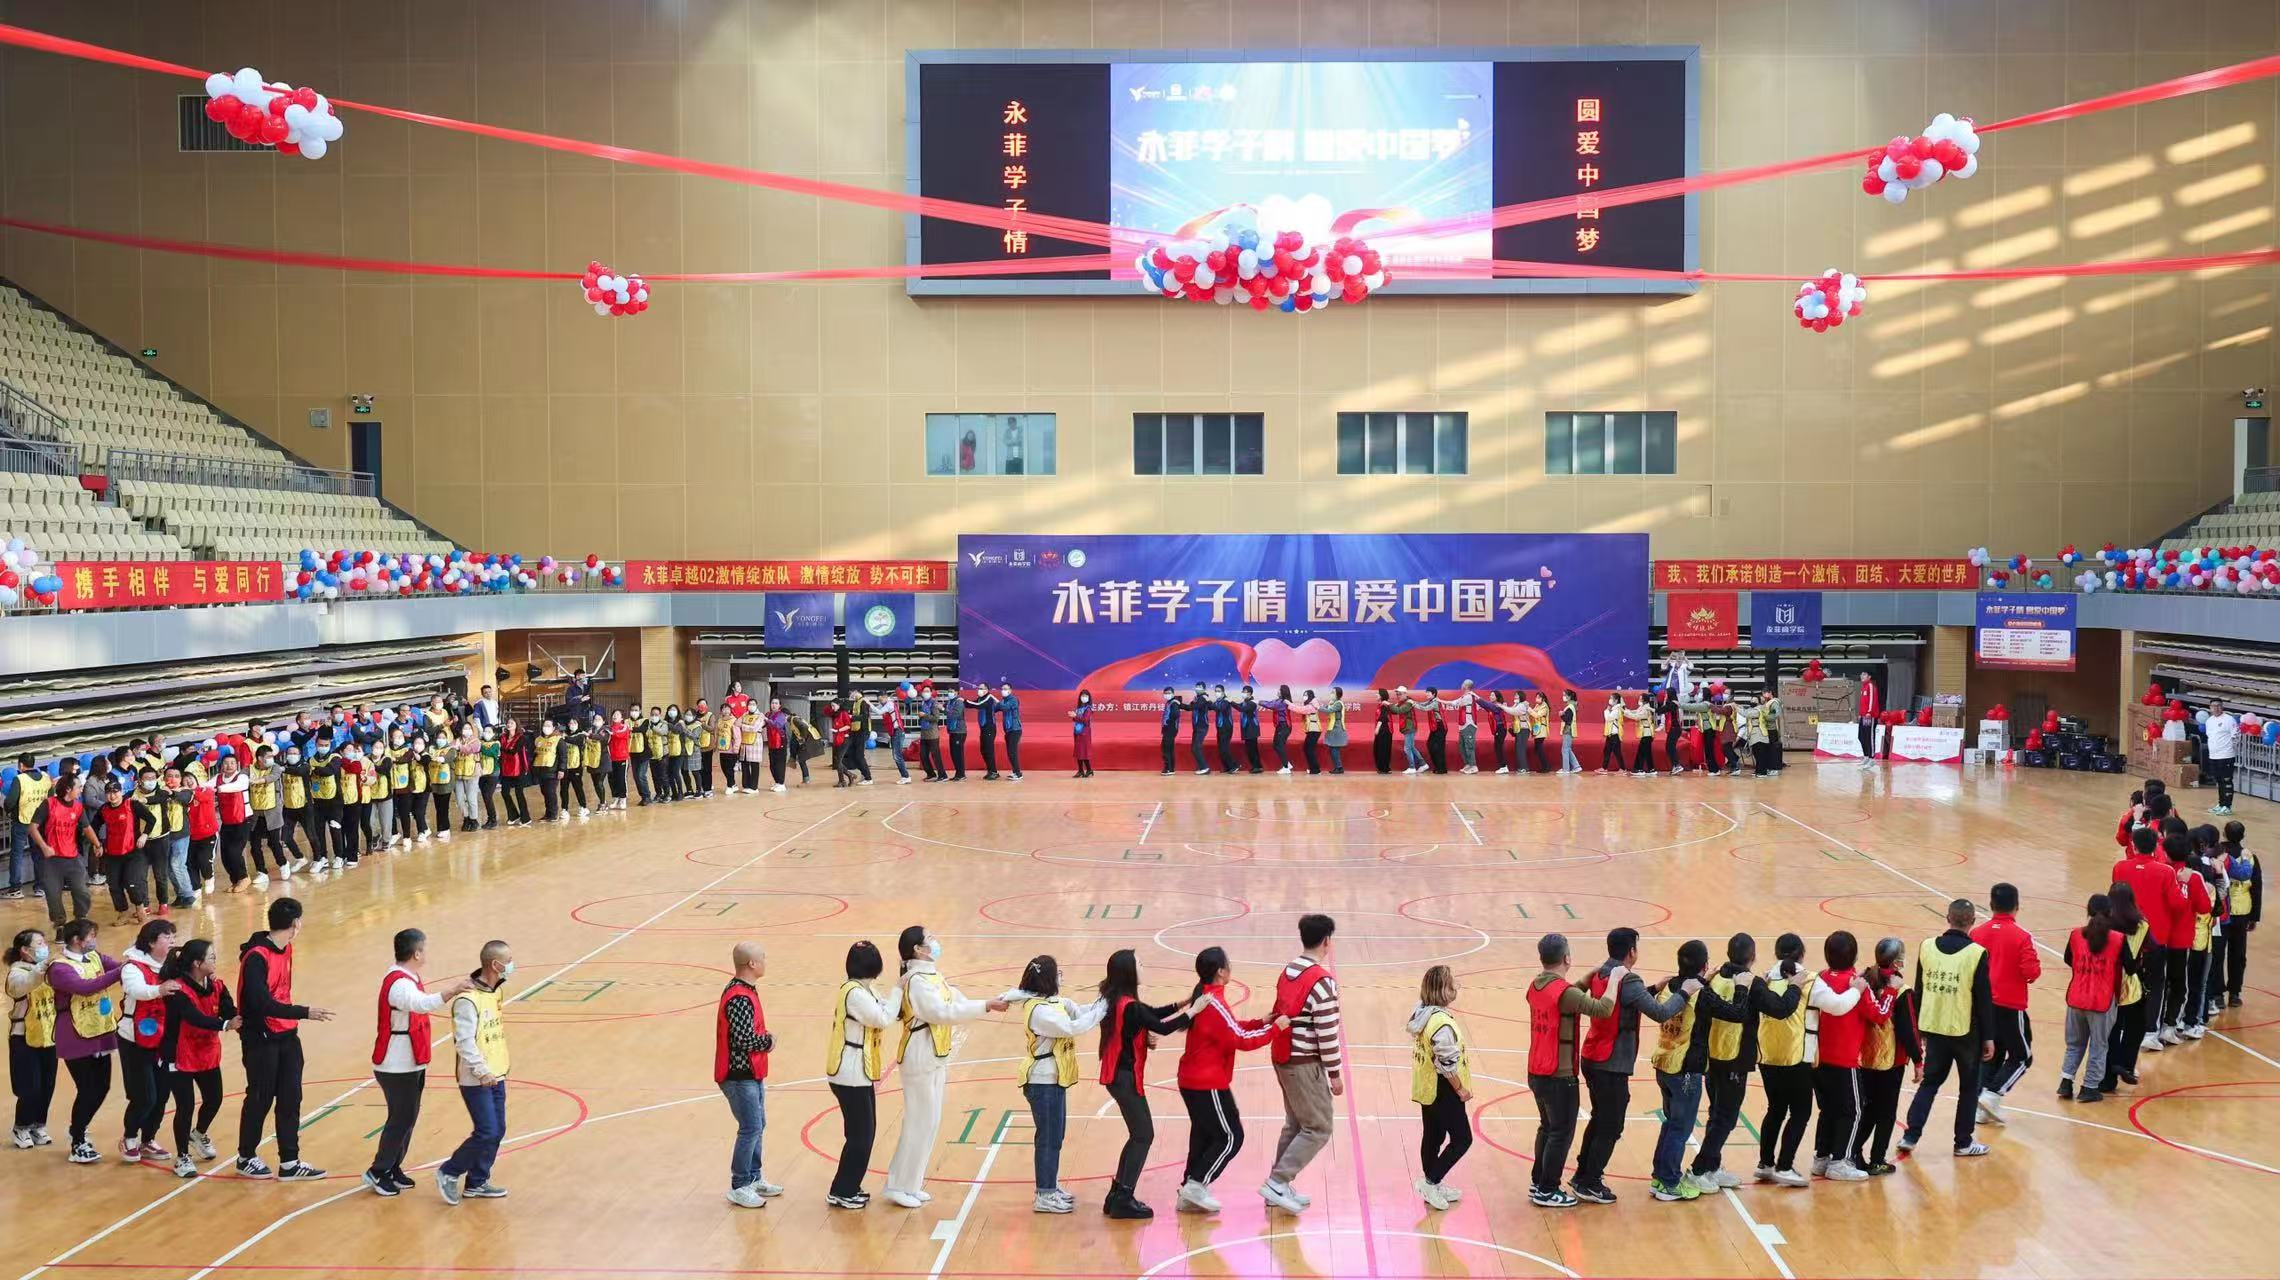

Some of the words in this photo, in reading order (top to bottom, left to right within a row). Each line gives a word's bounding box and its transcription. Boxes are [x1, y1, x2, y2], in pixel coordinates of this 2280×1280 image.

[1003, 100, 1028, 254] 永菲学子情
[1576, 98, 1600, 252] 圆爱中国梦
[75, 566, 170, 599] 携手相伴
[193, 565, 270, 594] 与爱同行
[643, 565, 791, 585] 永菲卓越02激情绽放队
[800, 565, 860, 585] 激情绽放
[1667, 563, 1967, 584] 我、我们承诺创造一个激情、团结、大爱的世界
[1052, 578, 1287, 624] 永菲学子情
[1307, 578, 1543, 624] 圆爱中国梦
[1508, 903, 1584, 920] 11
